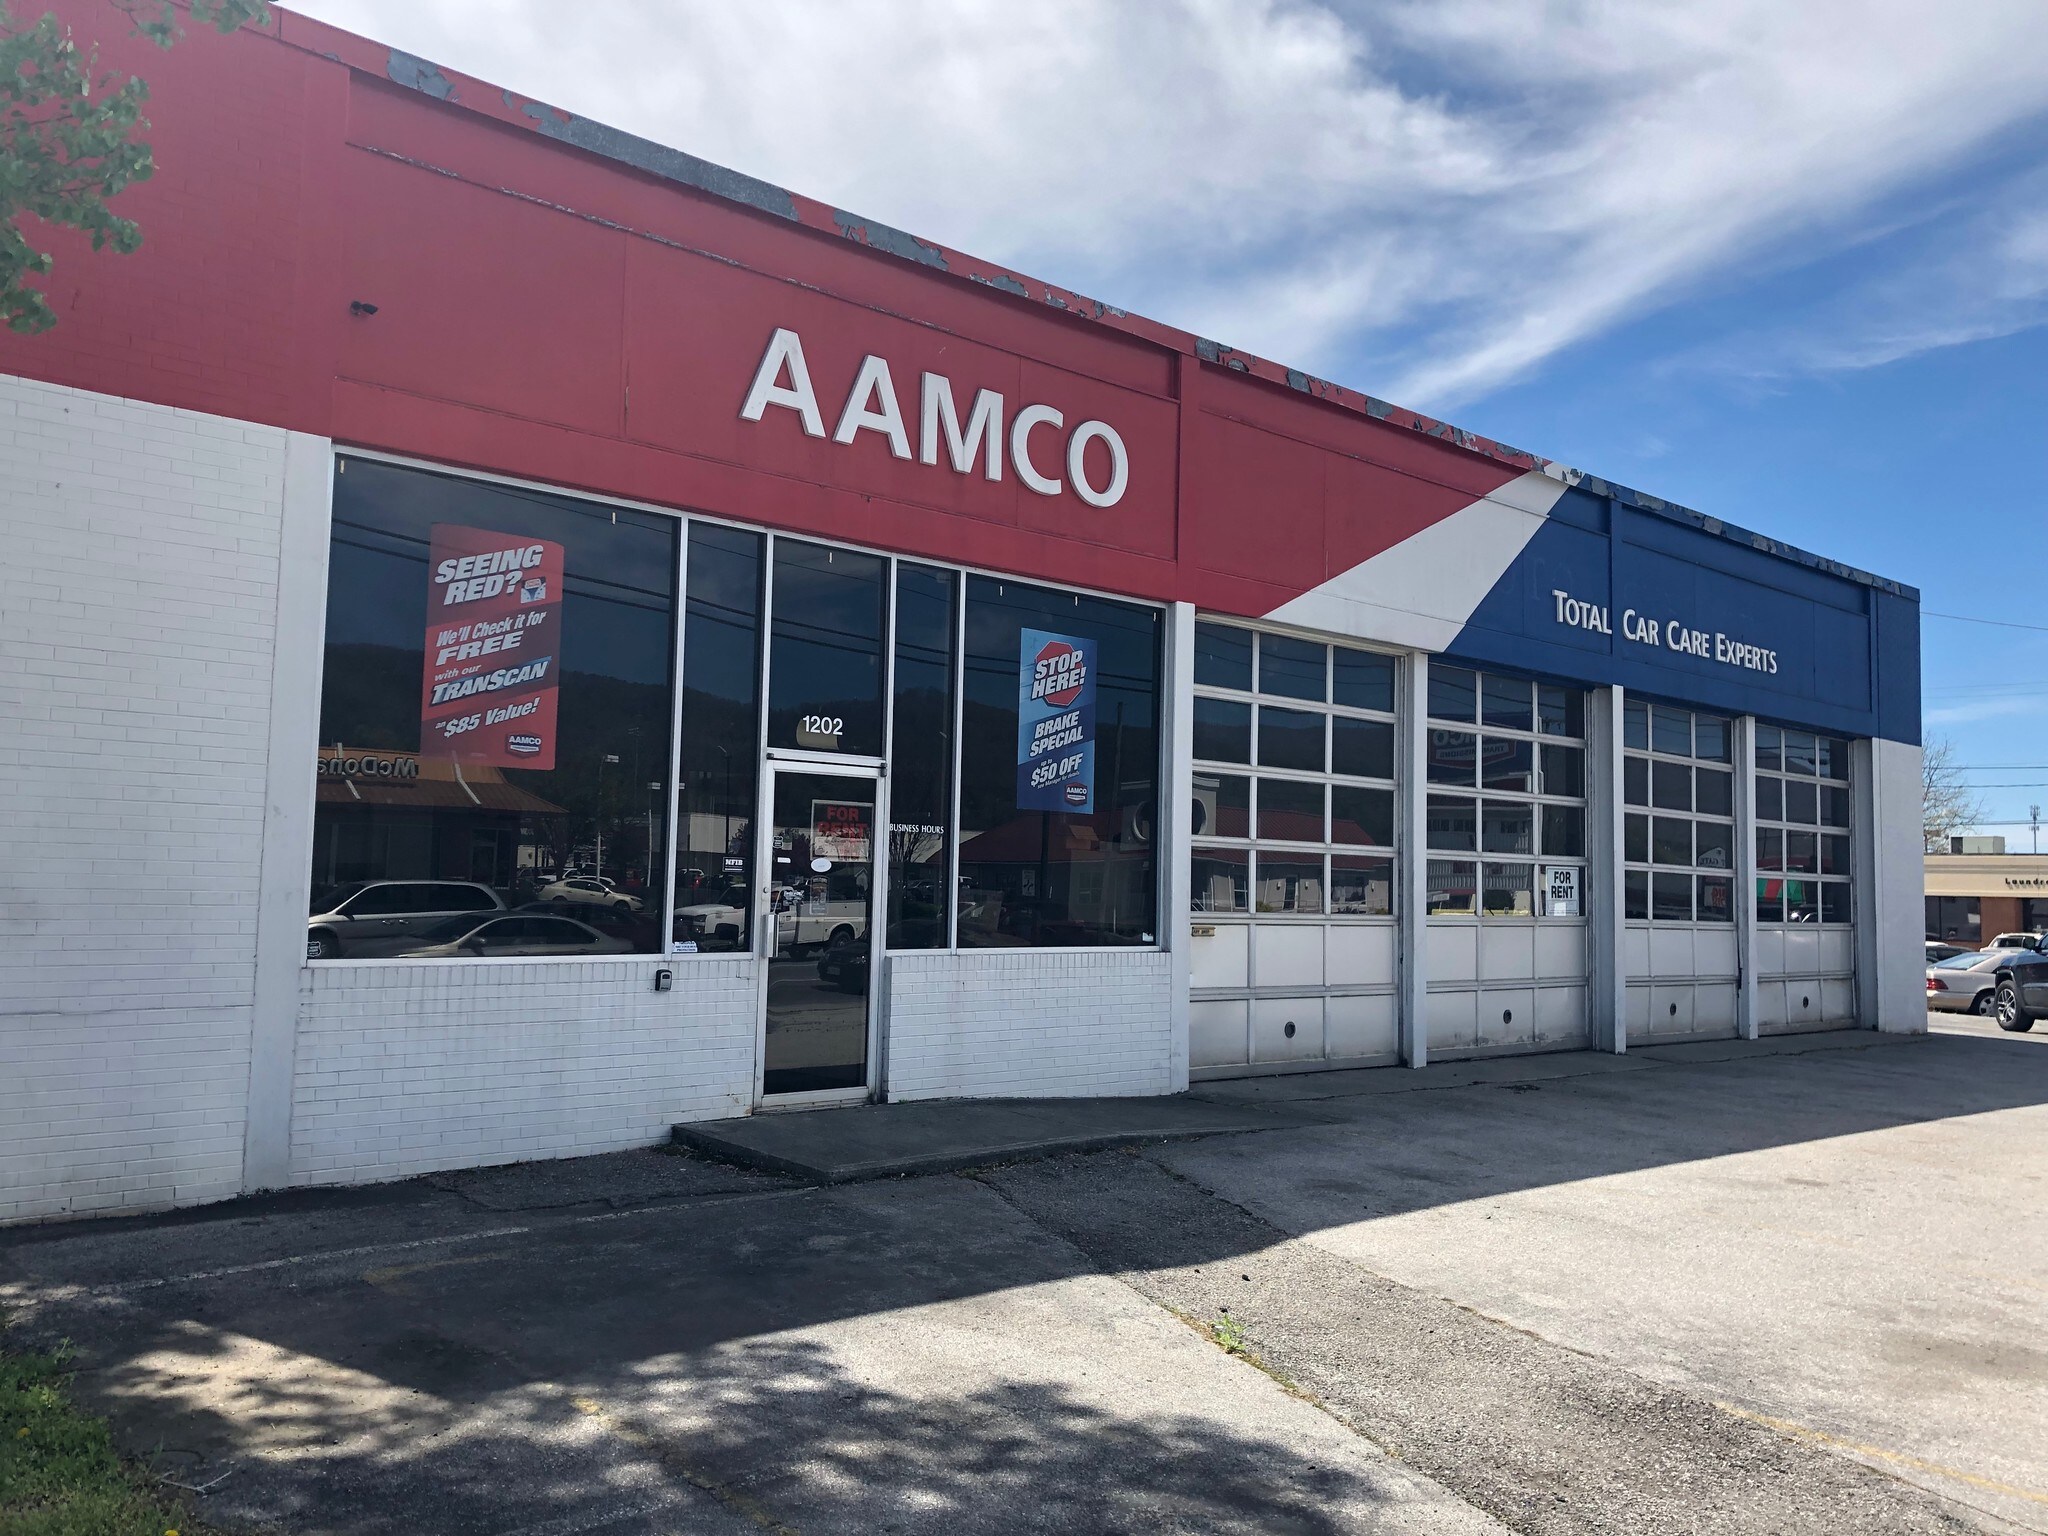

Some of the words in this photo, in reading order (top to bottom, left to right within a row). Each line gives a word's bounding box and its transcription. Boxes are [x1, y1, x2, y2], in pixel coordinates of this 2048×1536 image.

[738, 327, 1129, 508] AAMCO
[434, 544, 544, 584] SEEING
[443, 570, 523, 606] RED?
[435, 626, 470, 649] We'll
[471, 617, 514, 640] Check
[514, 612, 528, 629] it
[527, 609, 547, 628] for
[1551, 589, 1613, 635] TOTAL
[1623, 608, 1660, 647] CAR
[1666, 620, 1711, 659] CARE
[1715, 633, 1778, 675] EXPERTS
[435, 630, 524, 667] FREE
[434, 667, 459, 682] with
[461, 663, 482, 676] our
[1034, 650, 1084, 680] STOP
[1031, 666, 1087, 700] HERE!
[435, 720, 445, 730] an
[444, 711, 480, 738] $85
[485, 697, 540, 726] Value!
[802, 715, 843, 736] 1202
[1034, 710, 1080, 740] BRAKE
[508, 735, 542, 746] AAMCO
[1029, 725, 1084, 758] SPECIAL
[1030, 762, 1057, 788] $50
[1059, 753, 1084, 776] OFF
[1066, 787, 1087, 795] AAMCO
[827, 805, 859, 821] FOR
[817, 821, 868, 838] RENT
[889, 823, 920, 833] BUSINESS
[921, 824, 945, 834] HOURS
[1551, 885, 1575, 899] RENT
[1553, 870, 1571, 884] FOR
